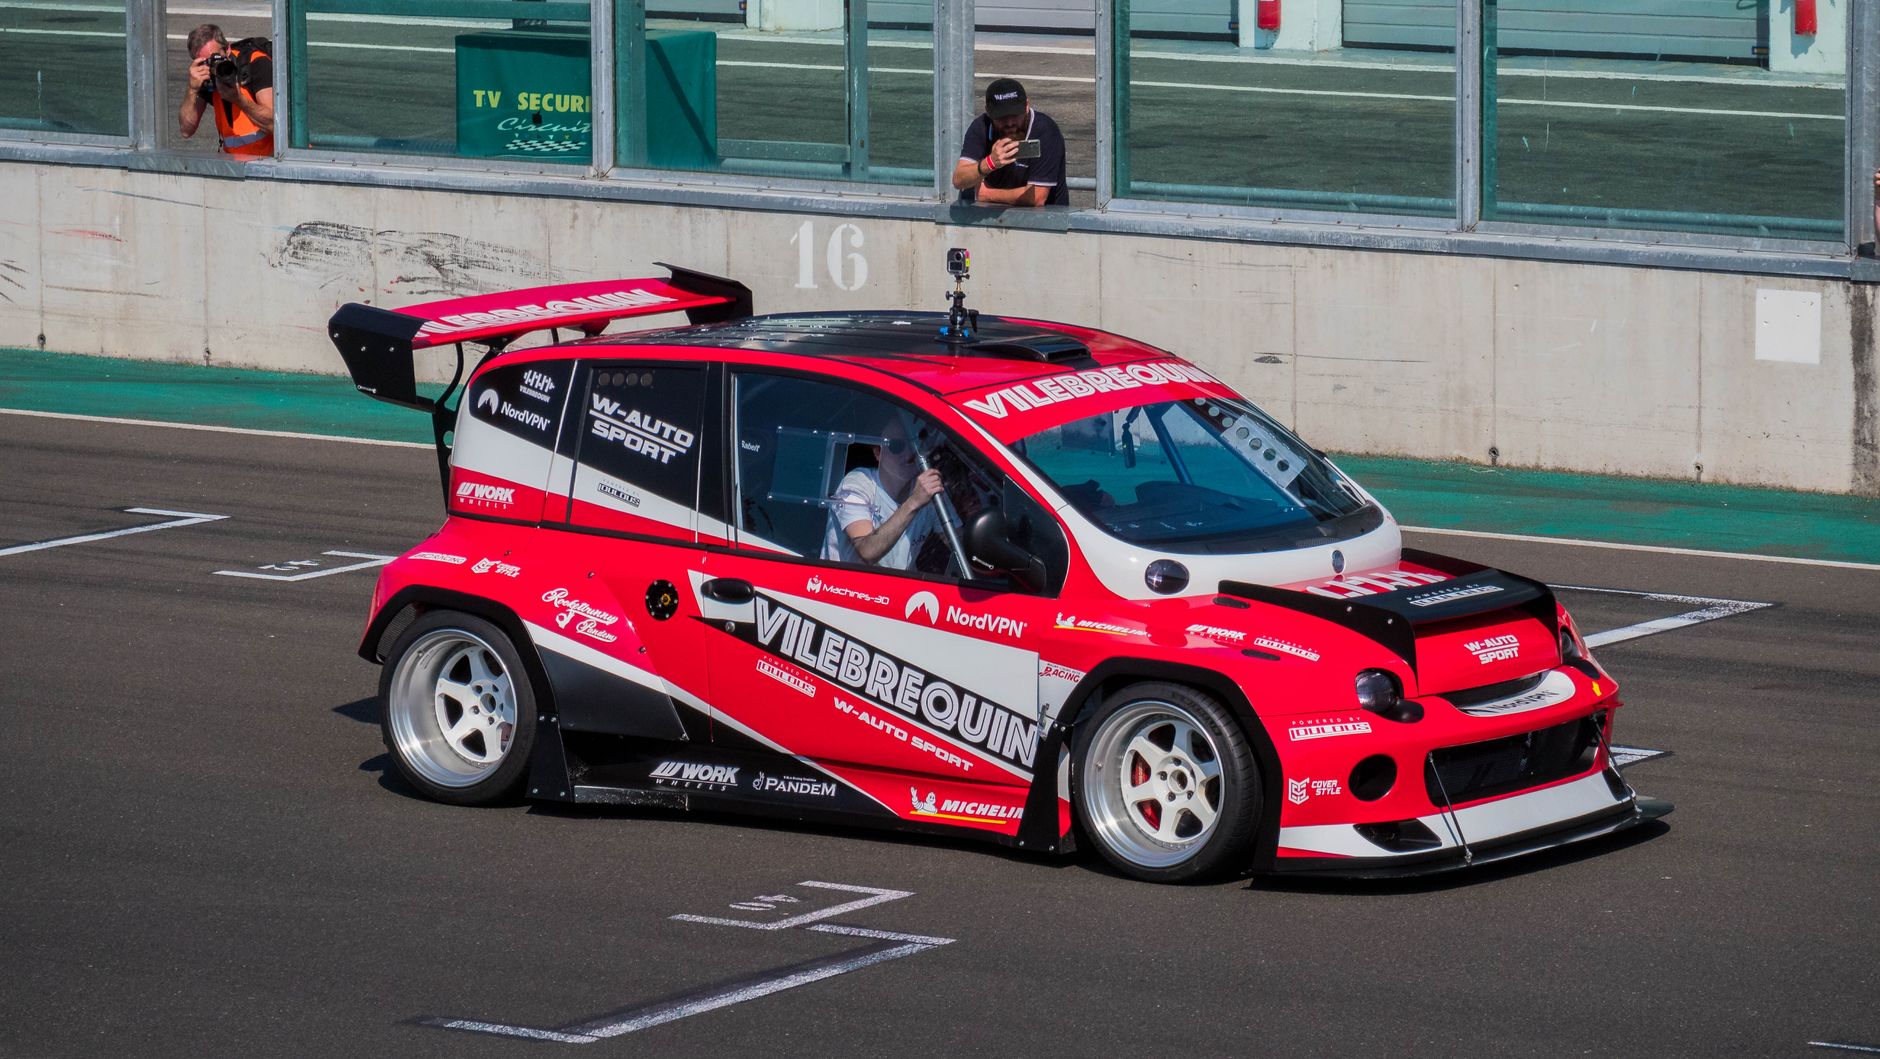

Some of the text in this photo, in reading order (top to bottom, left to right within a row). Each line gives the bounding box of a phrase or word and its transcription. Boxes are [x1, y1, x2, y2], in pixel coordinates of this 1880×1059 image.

[473, 89, 501, 108] TV
[790, 220, 869, 291] 16
[500, 401, 550, 431] NordVPN
[591, 392, 695, 449] W-AUTO
[591, 420, 677, 465] SPORT
[473, 485, 516, 503] WORK
[459, 498, 508, 510] WHEELS
[823, 584, 890, 605] Machines-3D
[946, 605, 1024, 639] NordVPN
[1076, 619, 1148, 637] MICHELIN
[1206, 626, 1248, 640] WORK
[1463, 634, 1518, 652] W-AUTO
[1478, 647, 1519, 665] SPORT
[762, 655, 815, 683] POWERED BY
[755, 596, 1039, 768] VILEBREQUIN
[1291, 717, 1343, 726] POWERED
[833, 696, 974, 772] W-AUTO SPORT
[681, 763, 741, 784] WORK
[655, 778, 727, 792] WHEELS
[1311, 780, 1338, 789] COVER
[1315, 787, 1342, 796] STYLE
